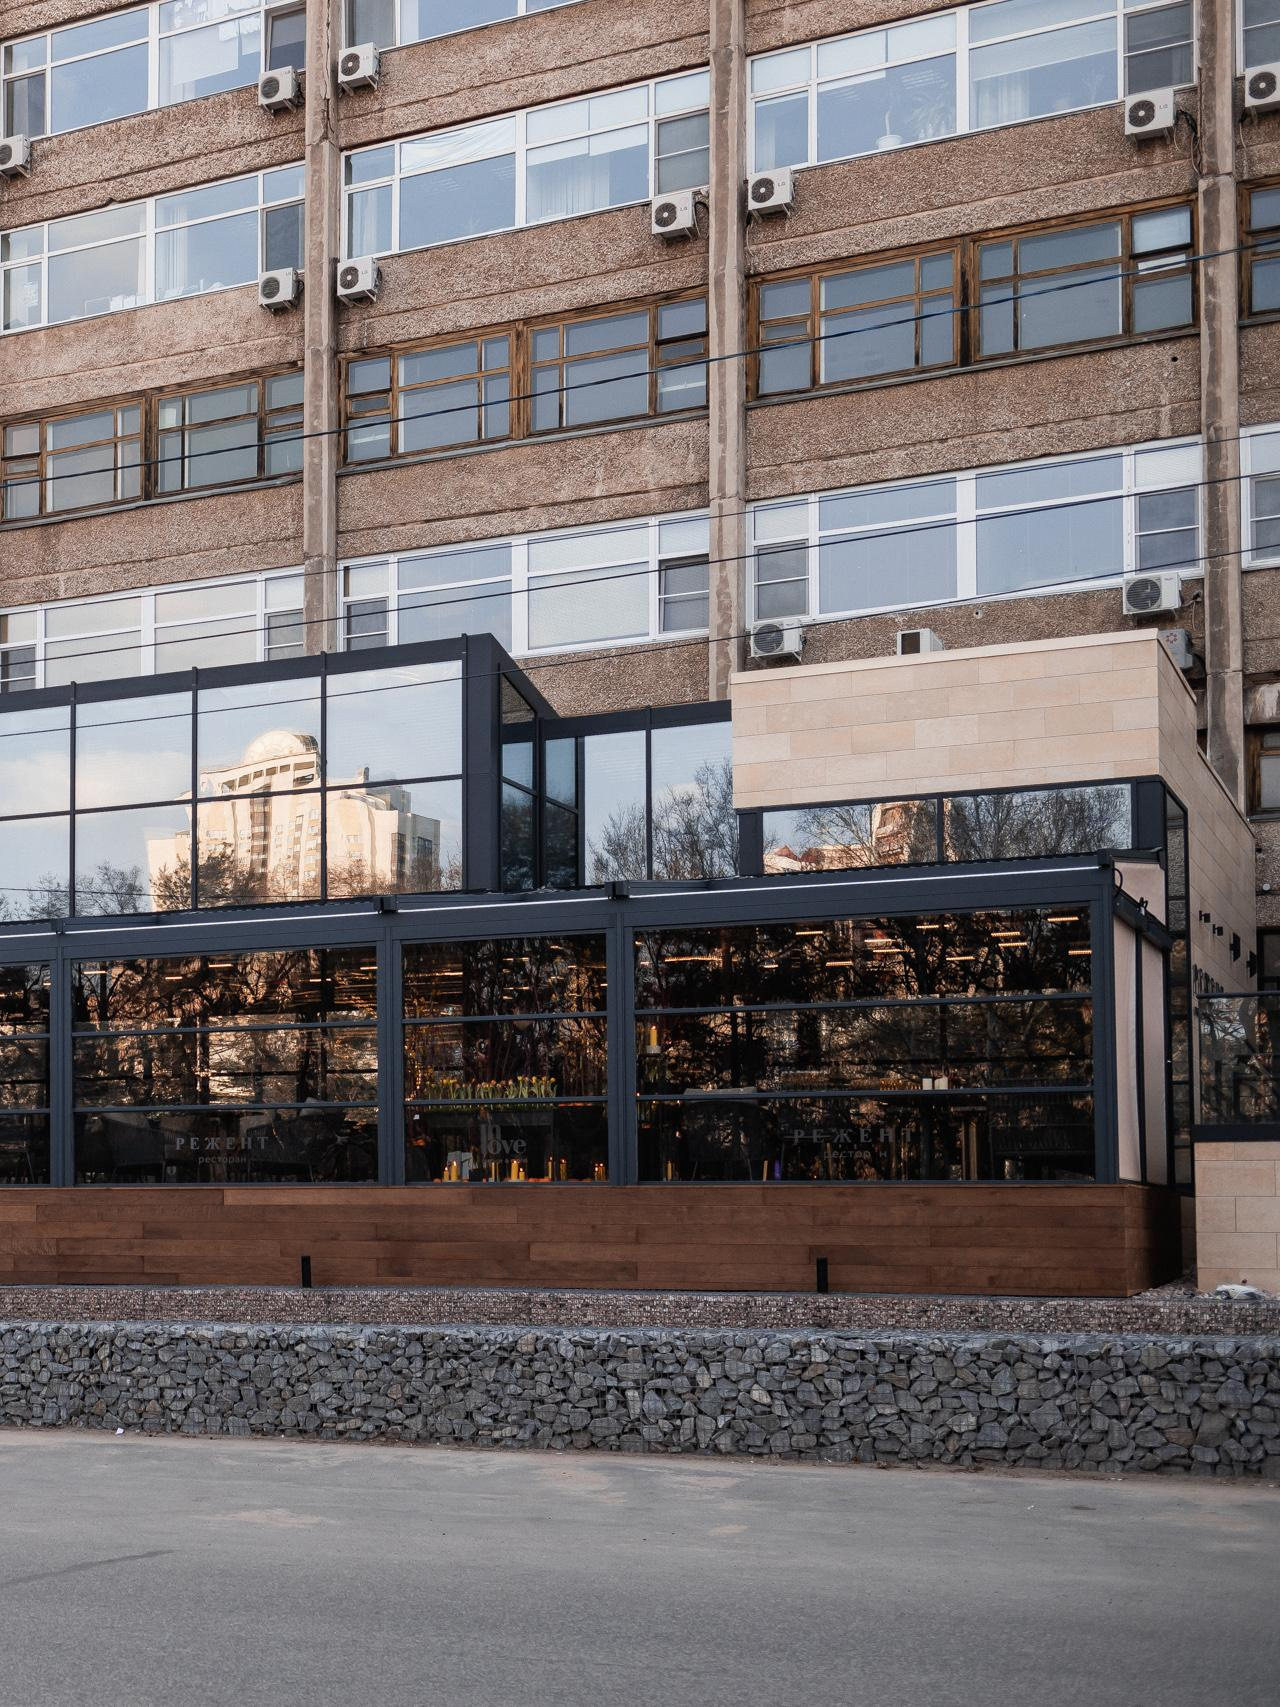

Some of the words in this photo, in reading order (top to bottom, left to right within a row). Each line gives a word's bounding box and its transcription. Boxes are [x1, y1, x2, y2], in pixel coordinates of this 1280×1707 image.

[793, 1127, 911, 1145] РЕЖЕНТ
[176, 1136, 269, 1151] РЕЖЕНТ
[198, 1155, 247, 1165] ресторан
[824, 1150, 887, 1160] ресторн
